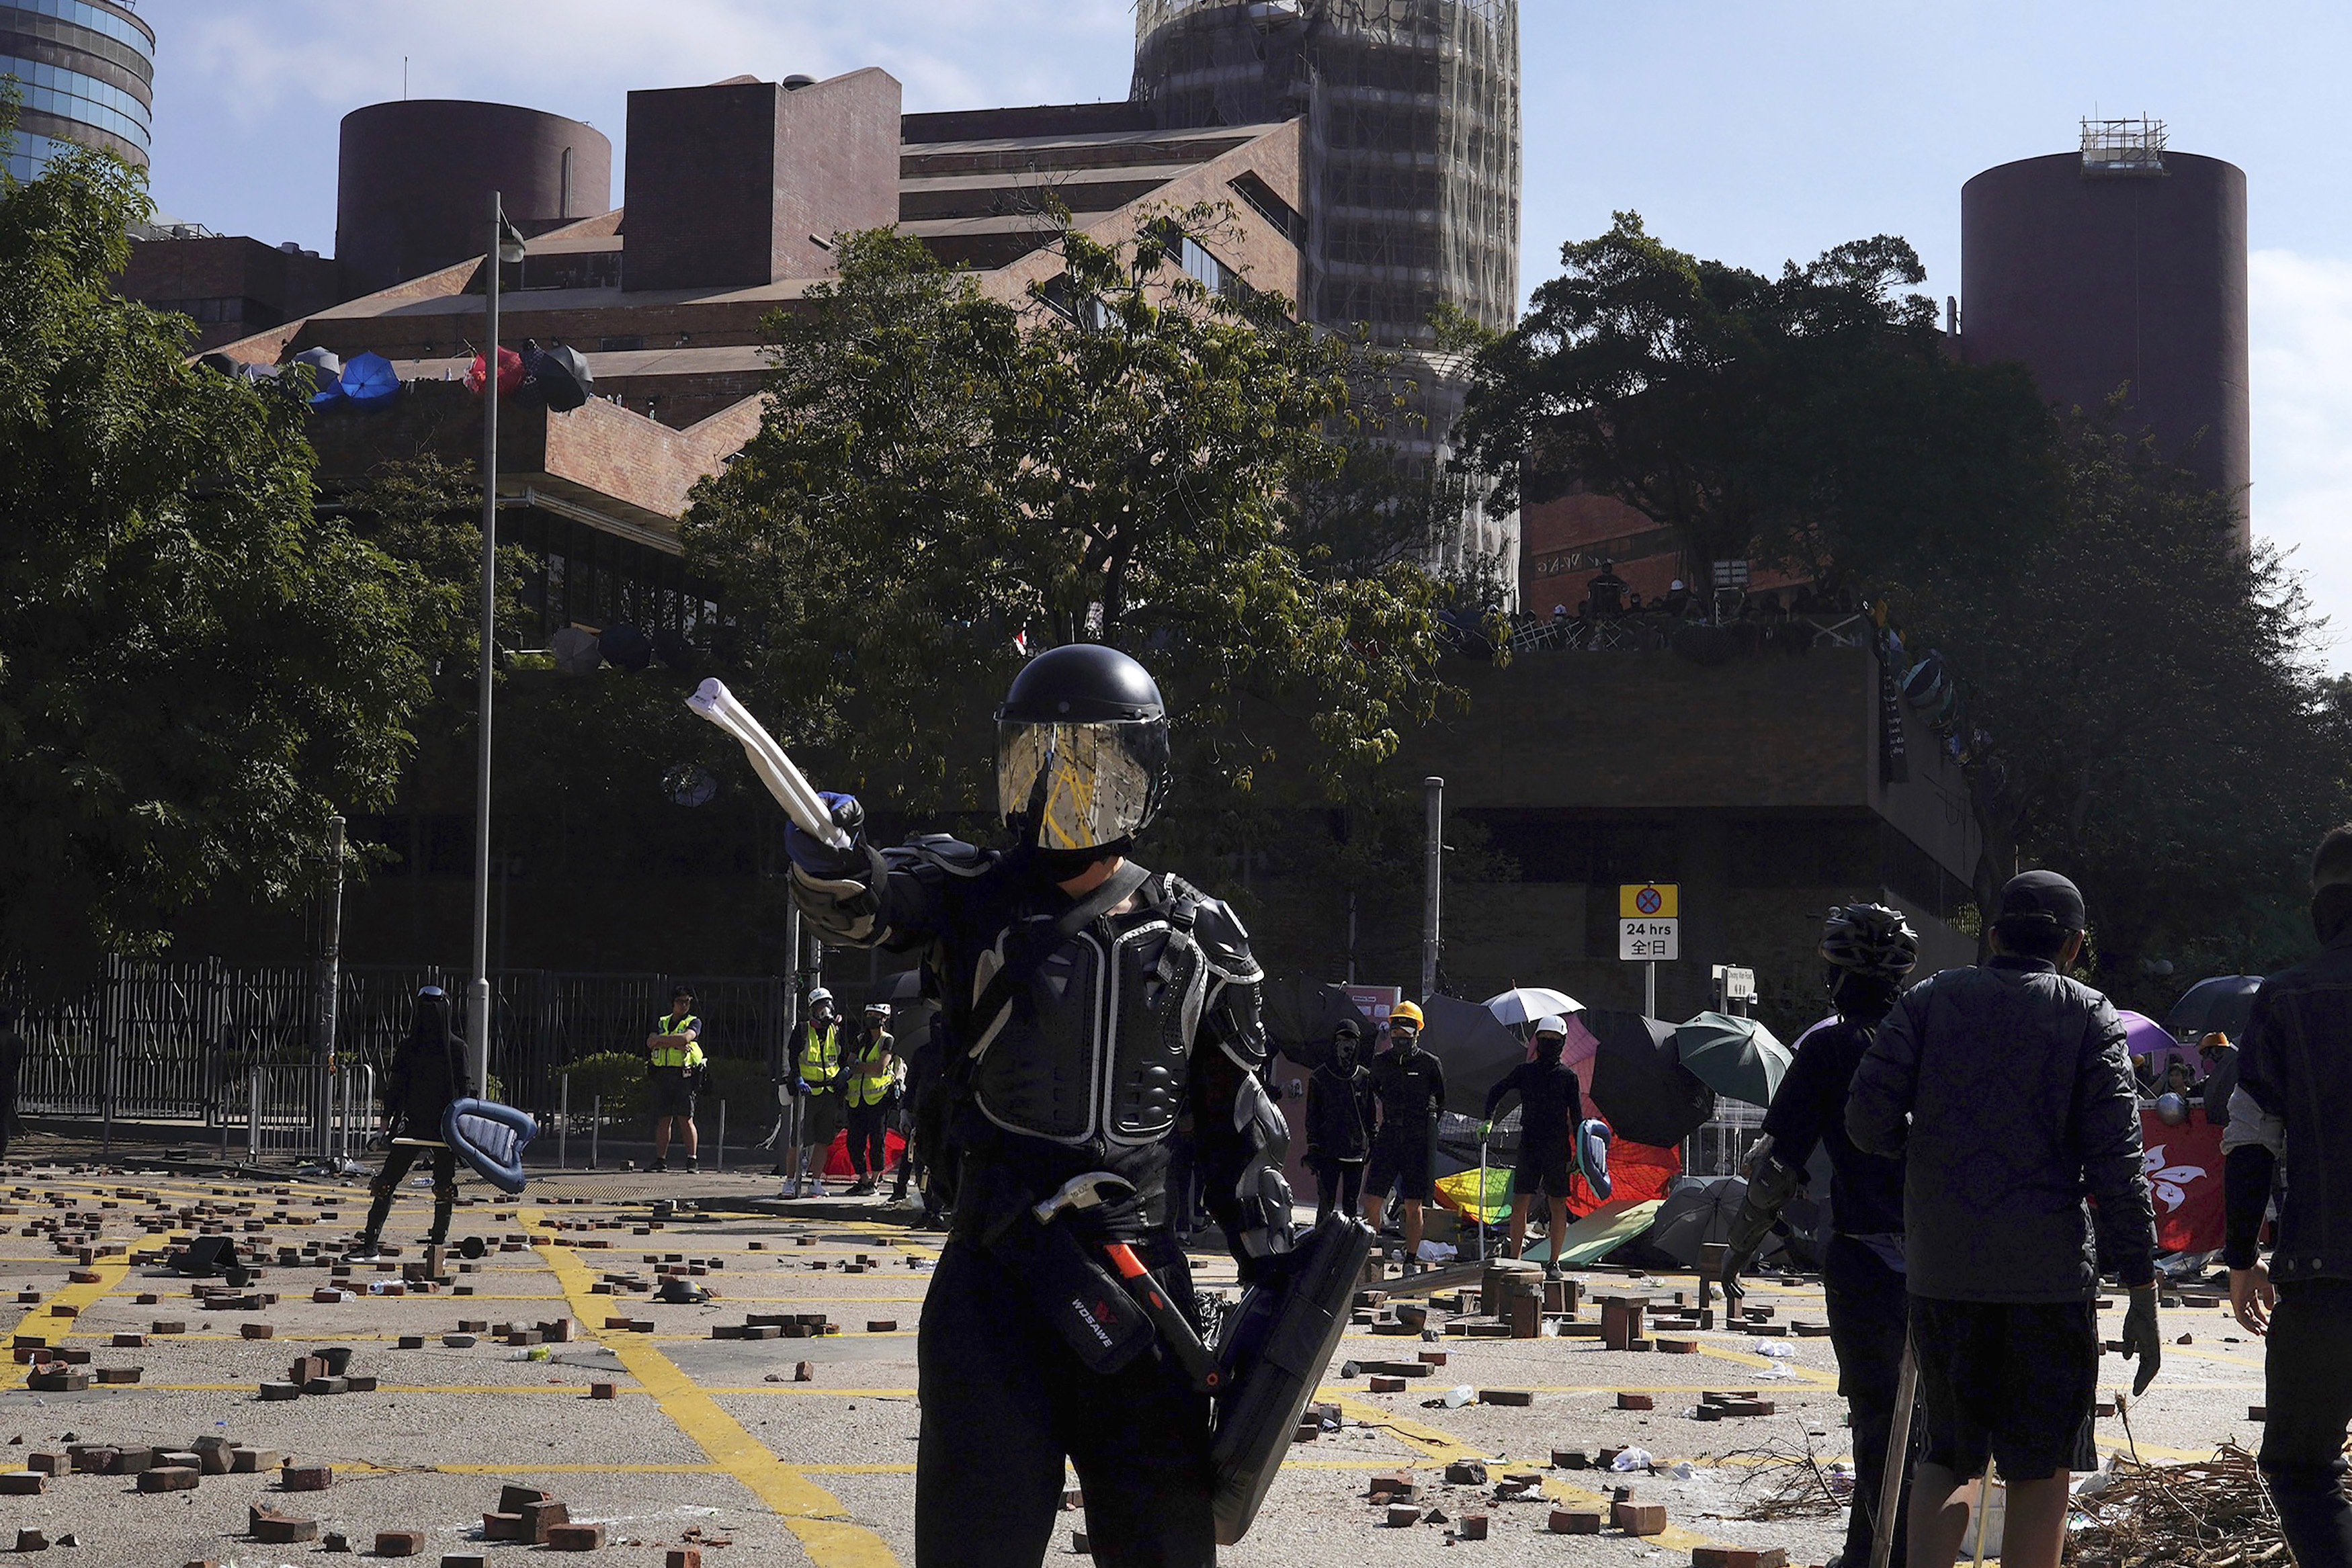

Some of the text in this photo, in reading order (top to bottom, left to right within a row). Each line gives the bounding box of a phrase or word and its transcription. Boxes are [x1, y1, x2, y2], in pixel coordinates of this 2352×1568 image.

[1626, 923, 1671, 935] 24 hrs
[1631, 939, 1665, 955] 全日
[1072, 1299, 1113, 1347] WOSAWE
